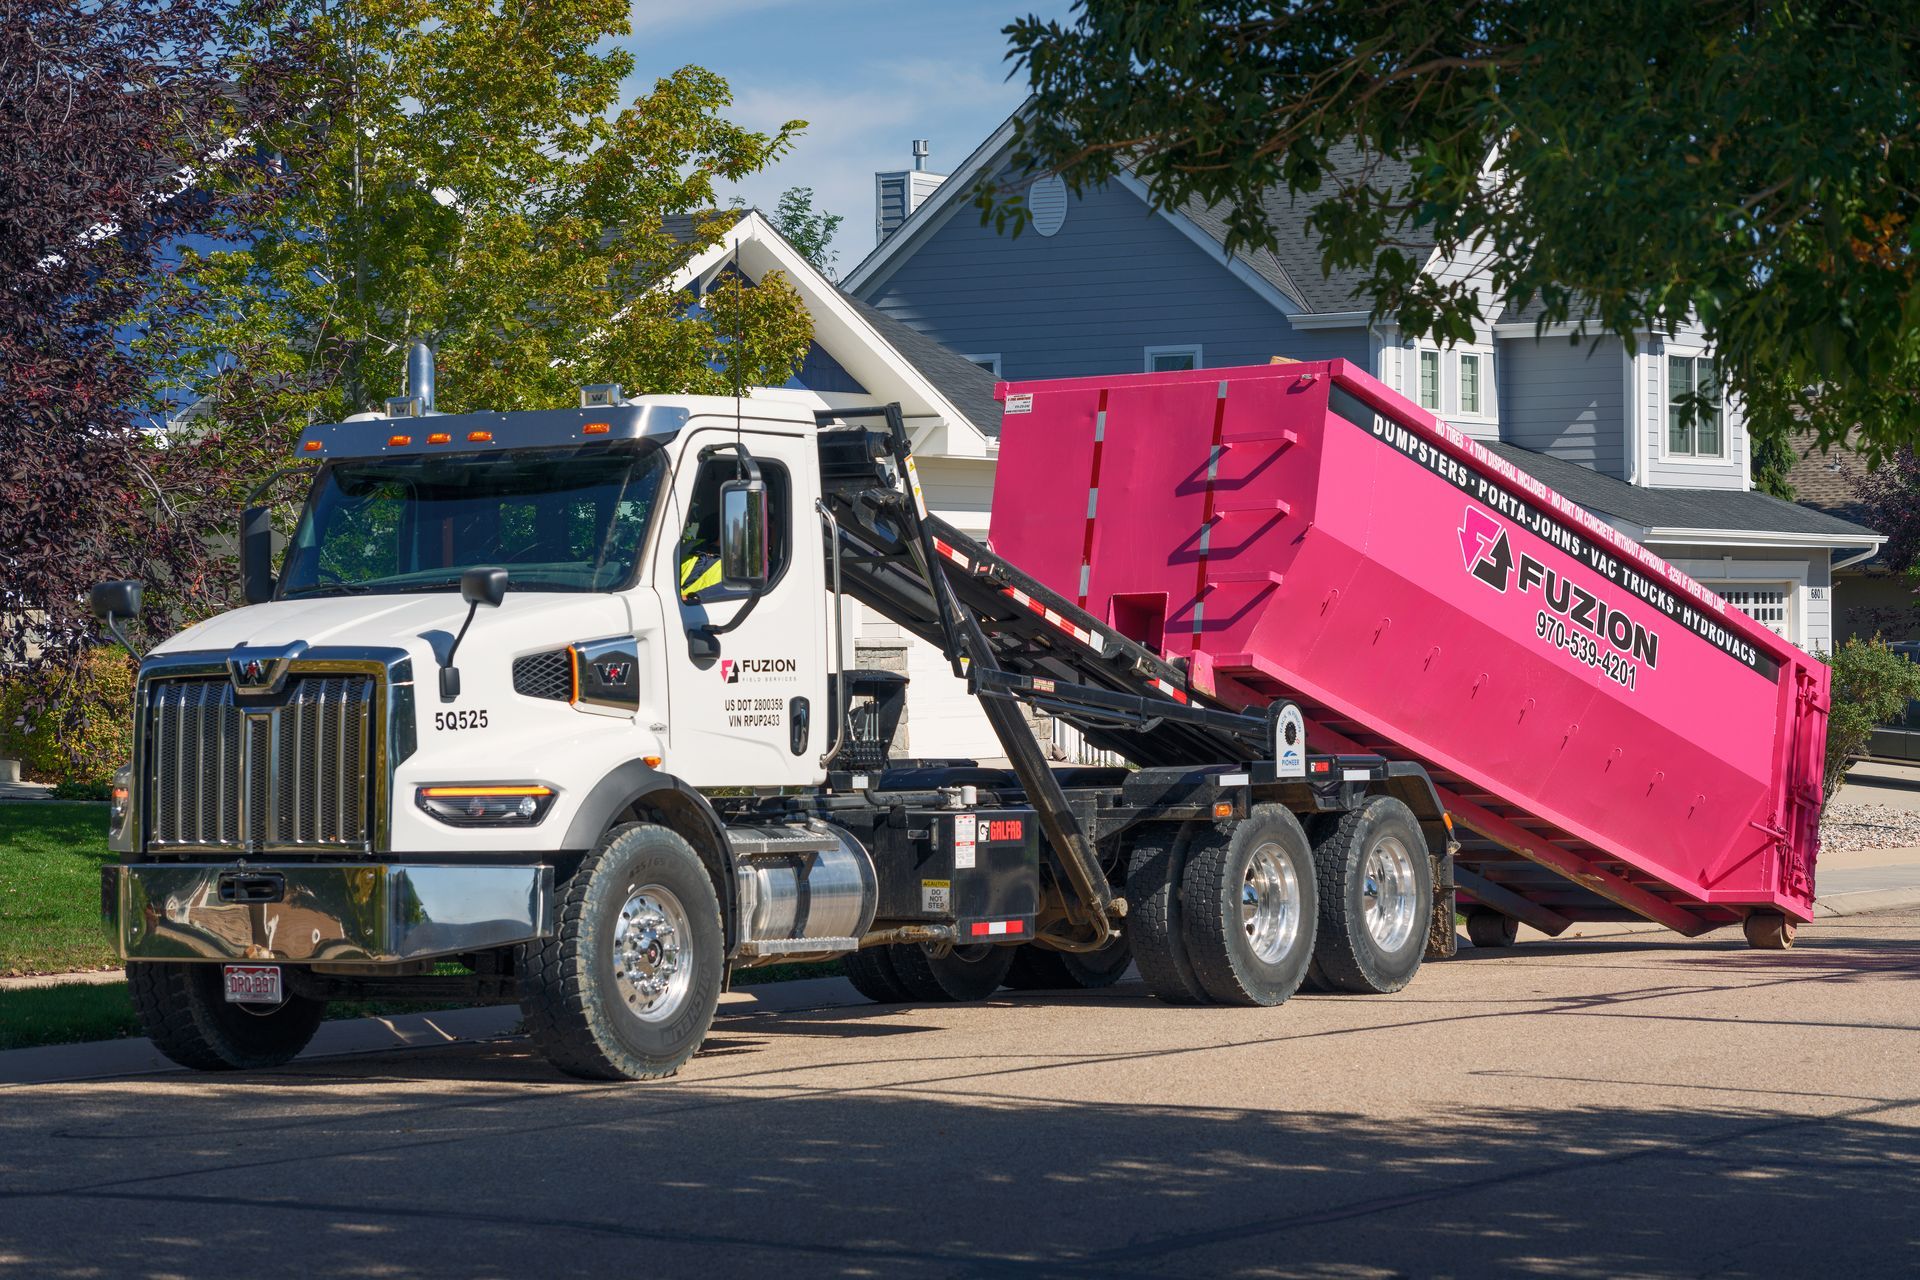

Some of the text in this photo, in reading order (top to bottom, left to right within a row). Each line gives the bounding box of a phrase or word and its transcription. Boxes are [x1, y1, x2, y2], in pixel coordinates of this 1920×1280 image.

[1435, 419, 1445, 438] NO
[1445, 422, 1464, 449] TIRES
[1474, 441, 1488, 464] TON
[1488, 449, 1517, 483] DISPOSAL
[1517, 467, 1546, 499] INCLUDED
[1551, 490, 1560, 508] NO
[1561, 497, 1575, 517] DIRT
[1575, 505, 1584, 522] OR
[1584, 510, 1614, 541] CONCRETE
[1614, 528, 1640, 558] WITHOUT
[1640, 545, 1666, 575] APPROVAL
[1688, 579, 1701, 598] OVER
[1701, 587, 1714, 607] THIS
[1714, 596, 1726, 615] LINE
[1373, 413, 1757, 666] DUMPSTERS PORTA-JOHNS VAC TRUCKS HYDROVACS
[1811, 588, 1824, 599] 6801
[1517, 552, 1659, 670] FUZION
[1536, 610, 1636, 692] 970-539-4201
[742, 659, 796, 673] FUZION
[725, 698, 783, 711] US DOT 2800358
[435, 709, 488, 731] 5Q525
[728, 714, 780, 727] VIN RPUP2433
[990, 820, 1022, 840] GALFAB
